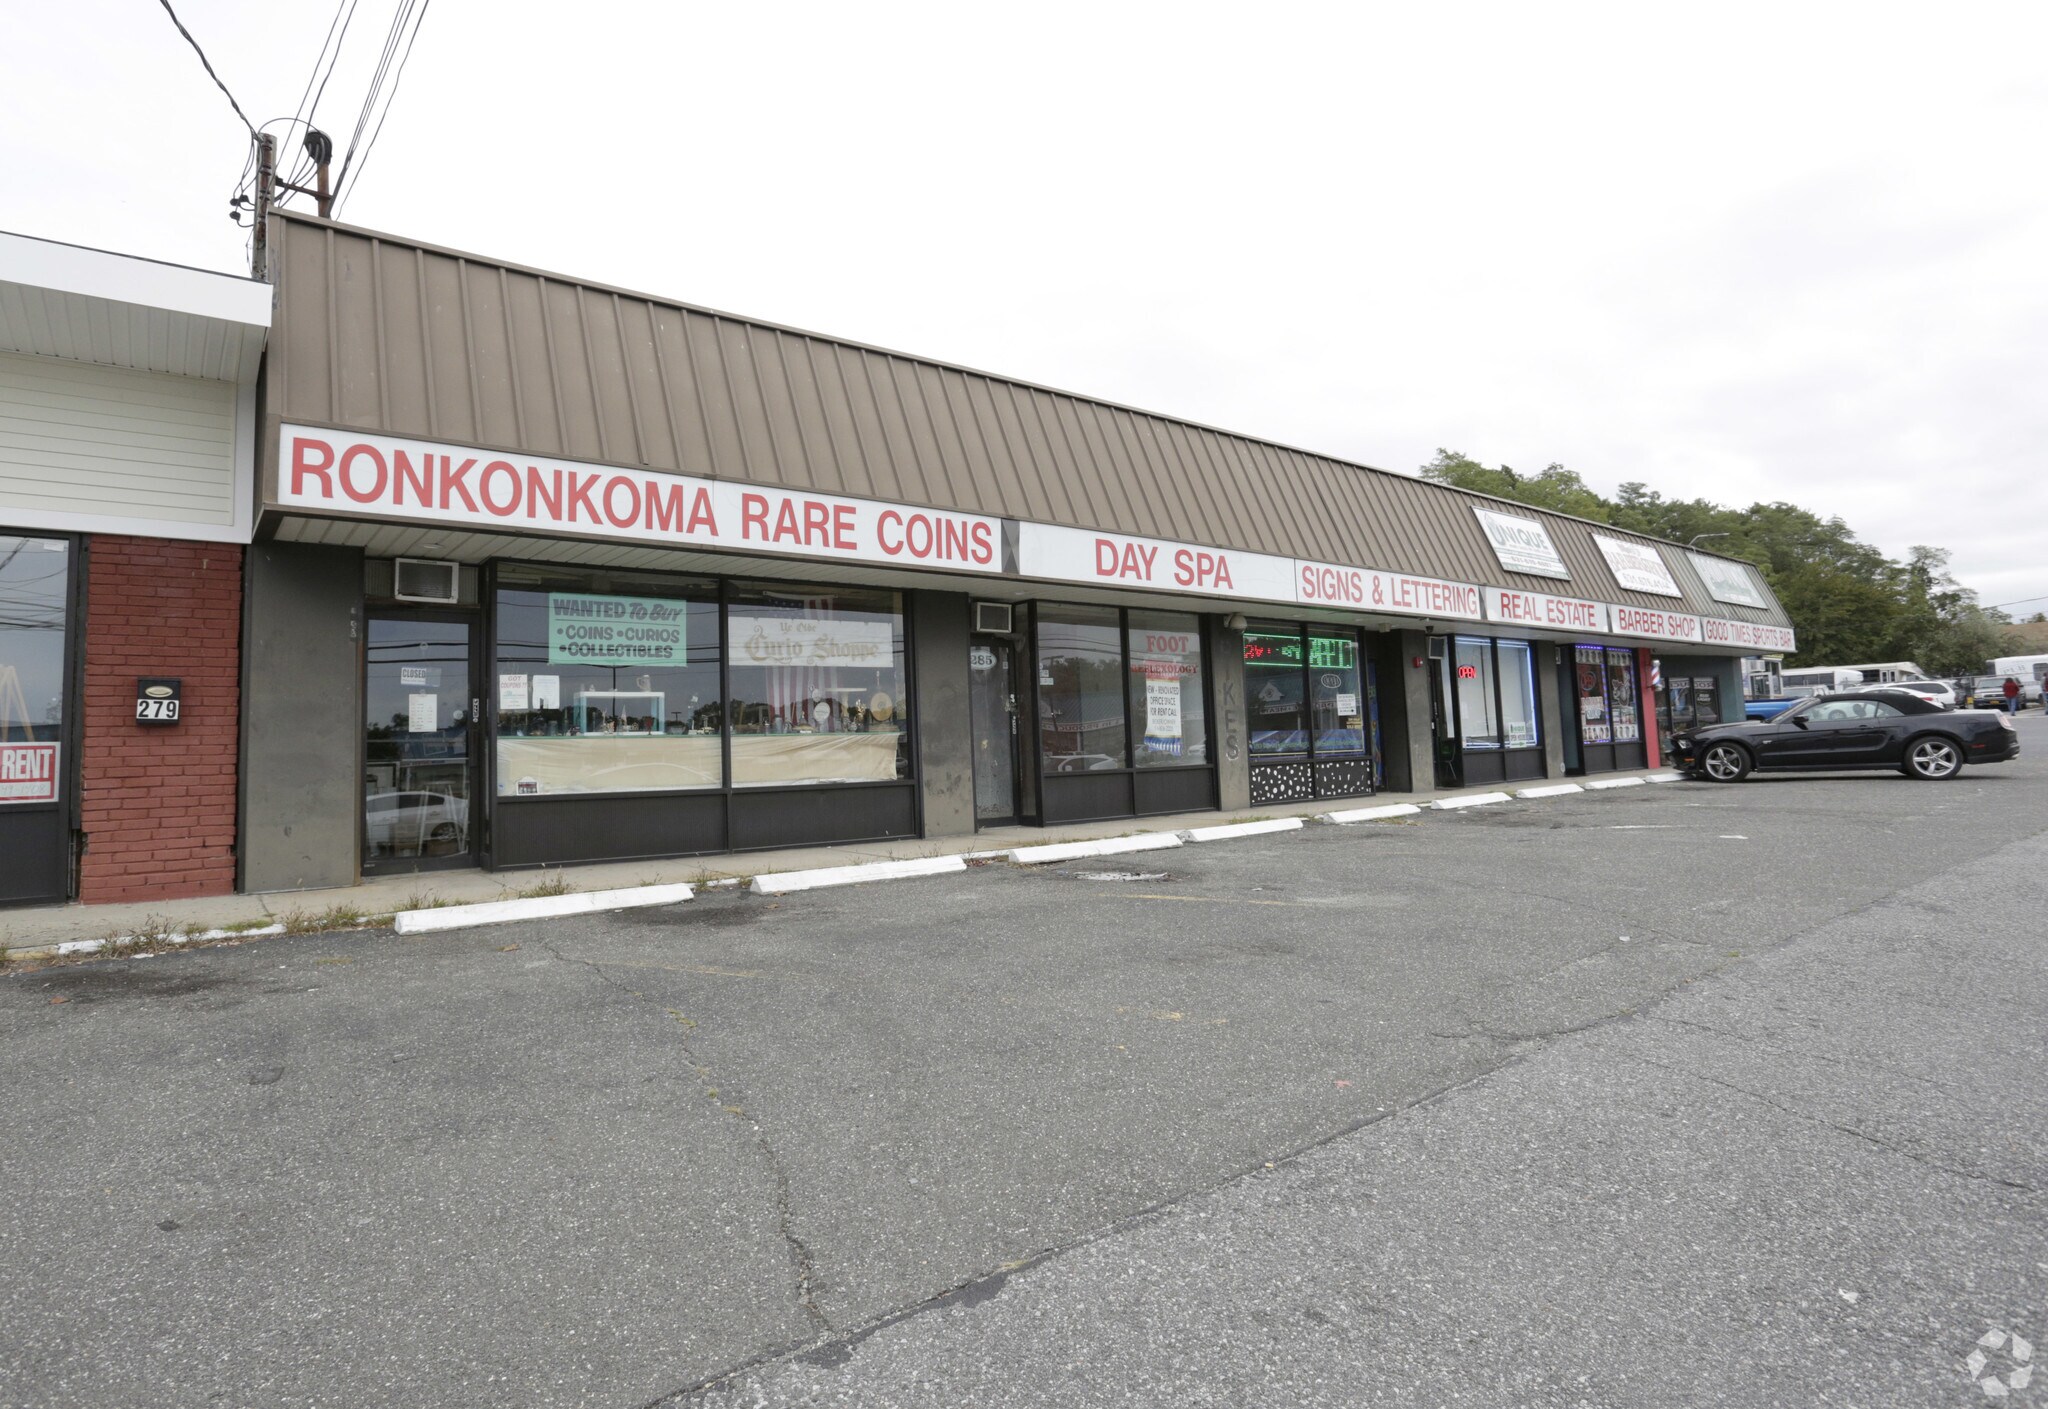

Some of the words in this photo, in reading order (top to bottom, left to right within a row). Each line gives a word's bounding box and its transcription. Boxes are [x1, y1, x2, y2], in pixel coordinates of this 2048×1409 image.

[290, 437, 719, 536] RONKONKOMA
[741, 493, 858, 550] RARE
[877, 510, 993, 565] COINS
[1486, 522, 1549, 550] UNIQUE
[1095, 538, 1158, 581] DAY
[1174, 548, 1234, 590] SPA
[1302, 565, 1363, 603] SIGNS
[1372, 575, 1384, 605] &
[1391, 577, 1478, 615] LETTERING
[553, 598, 626, 619] WANTED
[1500, 593, 1542, 622] REAL
[1547, 599, 1597, 628] ESTATE
[1618, 608, 1665, 635] BARBER
[1668, 614, 1696, 637] SHOP
[565, 624, 614, 641] COINS
[625, 627, 680, 643] CURIOS
[744, 625, 802, 665] Curio
[806, 633, 879, 664] Shoppe
[1146, 634, 1189, 653] FOOT
[1706, 620, 1729, 642] GOOD
[1730, 623, 1751, 644] TIMES
[1752, 626, 1778, 647] SPORTS
[1779, 630, 1792, 648] BAR
[568, 641, 673, 659] COLLECTIBLES
[971, 654, 993, 666] 285
[402, 668, 426, 679] CLOSED
[1458, 666, 1477, 679] OPEN
[138, 700, 177, 719] 279
[1, 749, 54, 780] RENT
